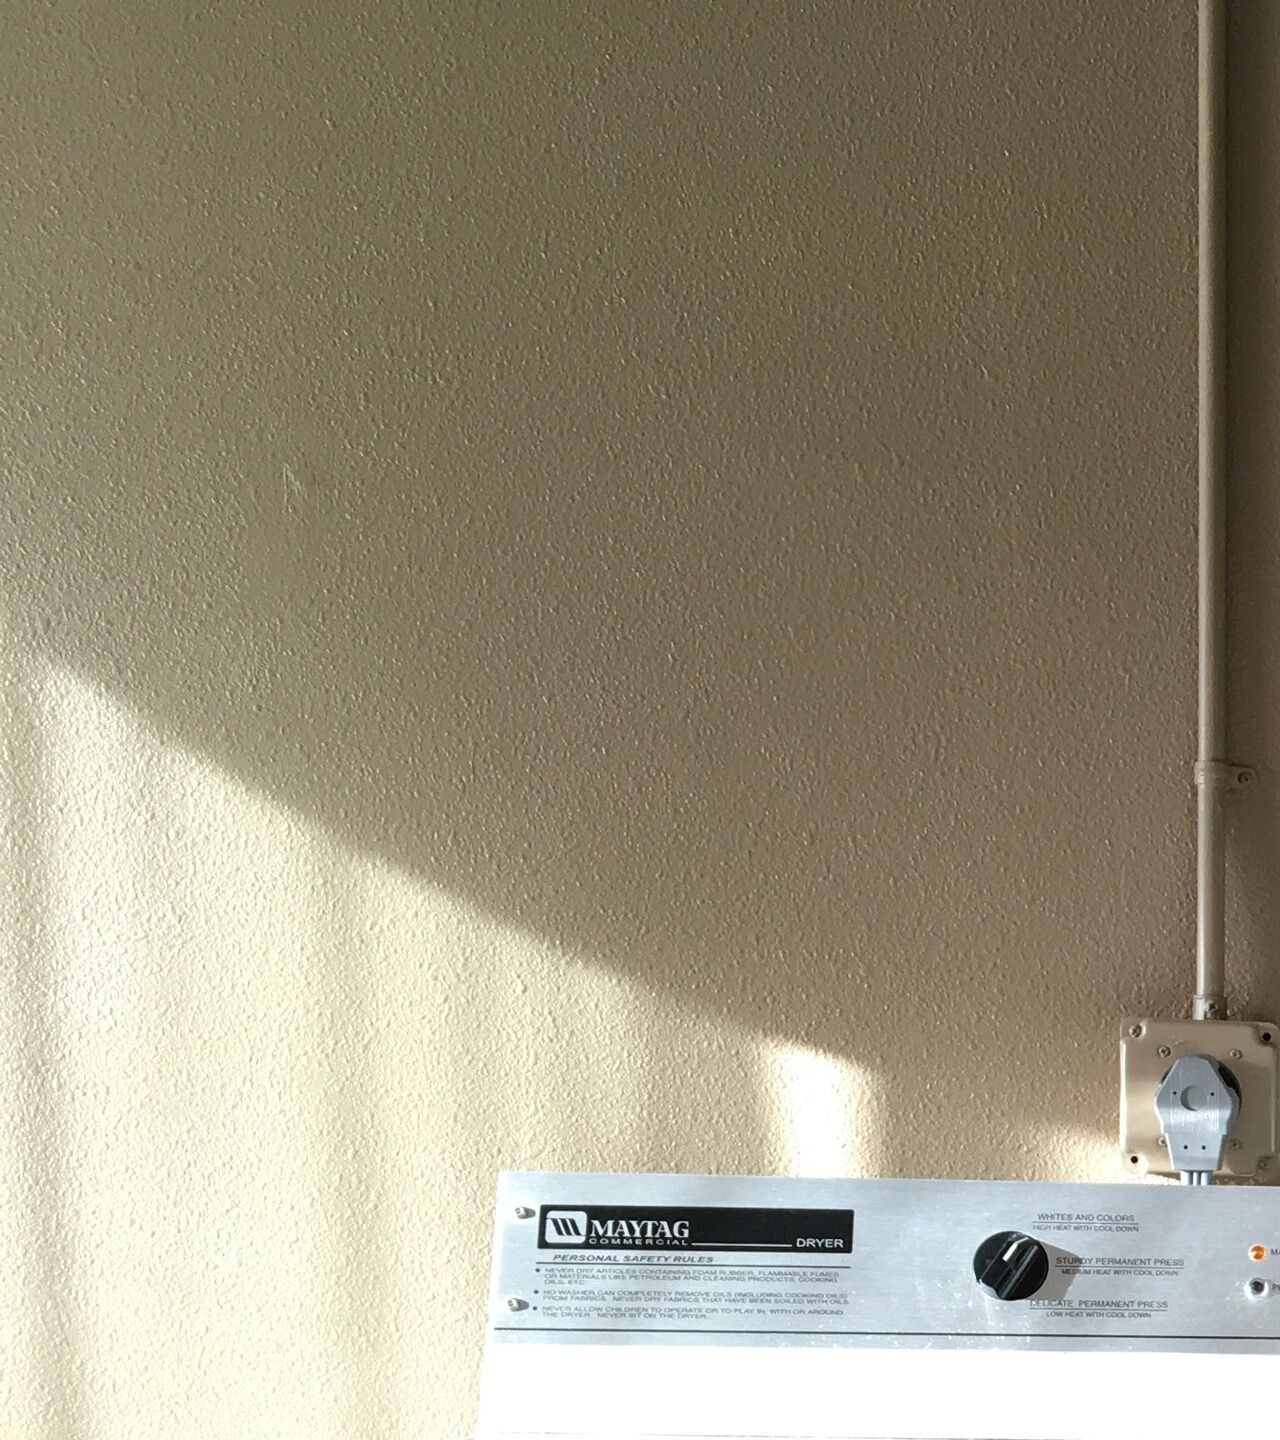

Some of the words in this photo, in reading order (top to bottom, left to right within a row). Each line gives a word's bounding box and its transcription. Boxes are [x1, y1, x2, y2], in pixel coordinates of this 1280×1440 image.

[1037, 1213, 1073, 1221] WHITES
[1075, 1213, 1095, 1221] AND
[1096, 1214, 1135, 1222] COLORS
[590, 1220, 690, 1238] MAYTAG
[795, 1236, 844, 1249] DRYER
[552, 1254, 619, 1262] PERSONAL
[623, 1255, 671, 1263] SAFETY
[1055, 1257, 1093, 1265] STURDY
[1095, 1257, 1152, 1266] PERMANENT
[1153, 1258, 1185, 1267] PRESS
[1030, 1299, 1073, 1308] DELICATE
[1078, 1300, 1136, 1309] PERMANENT
[1137, 1301, 1168, 1309] PRESS
